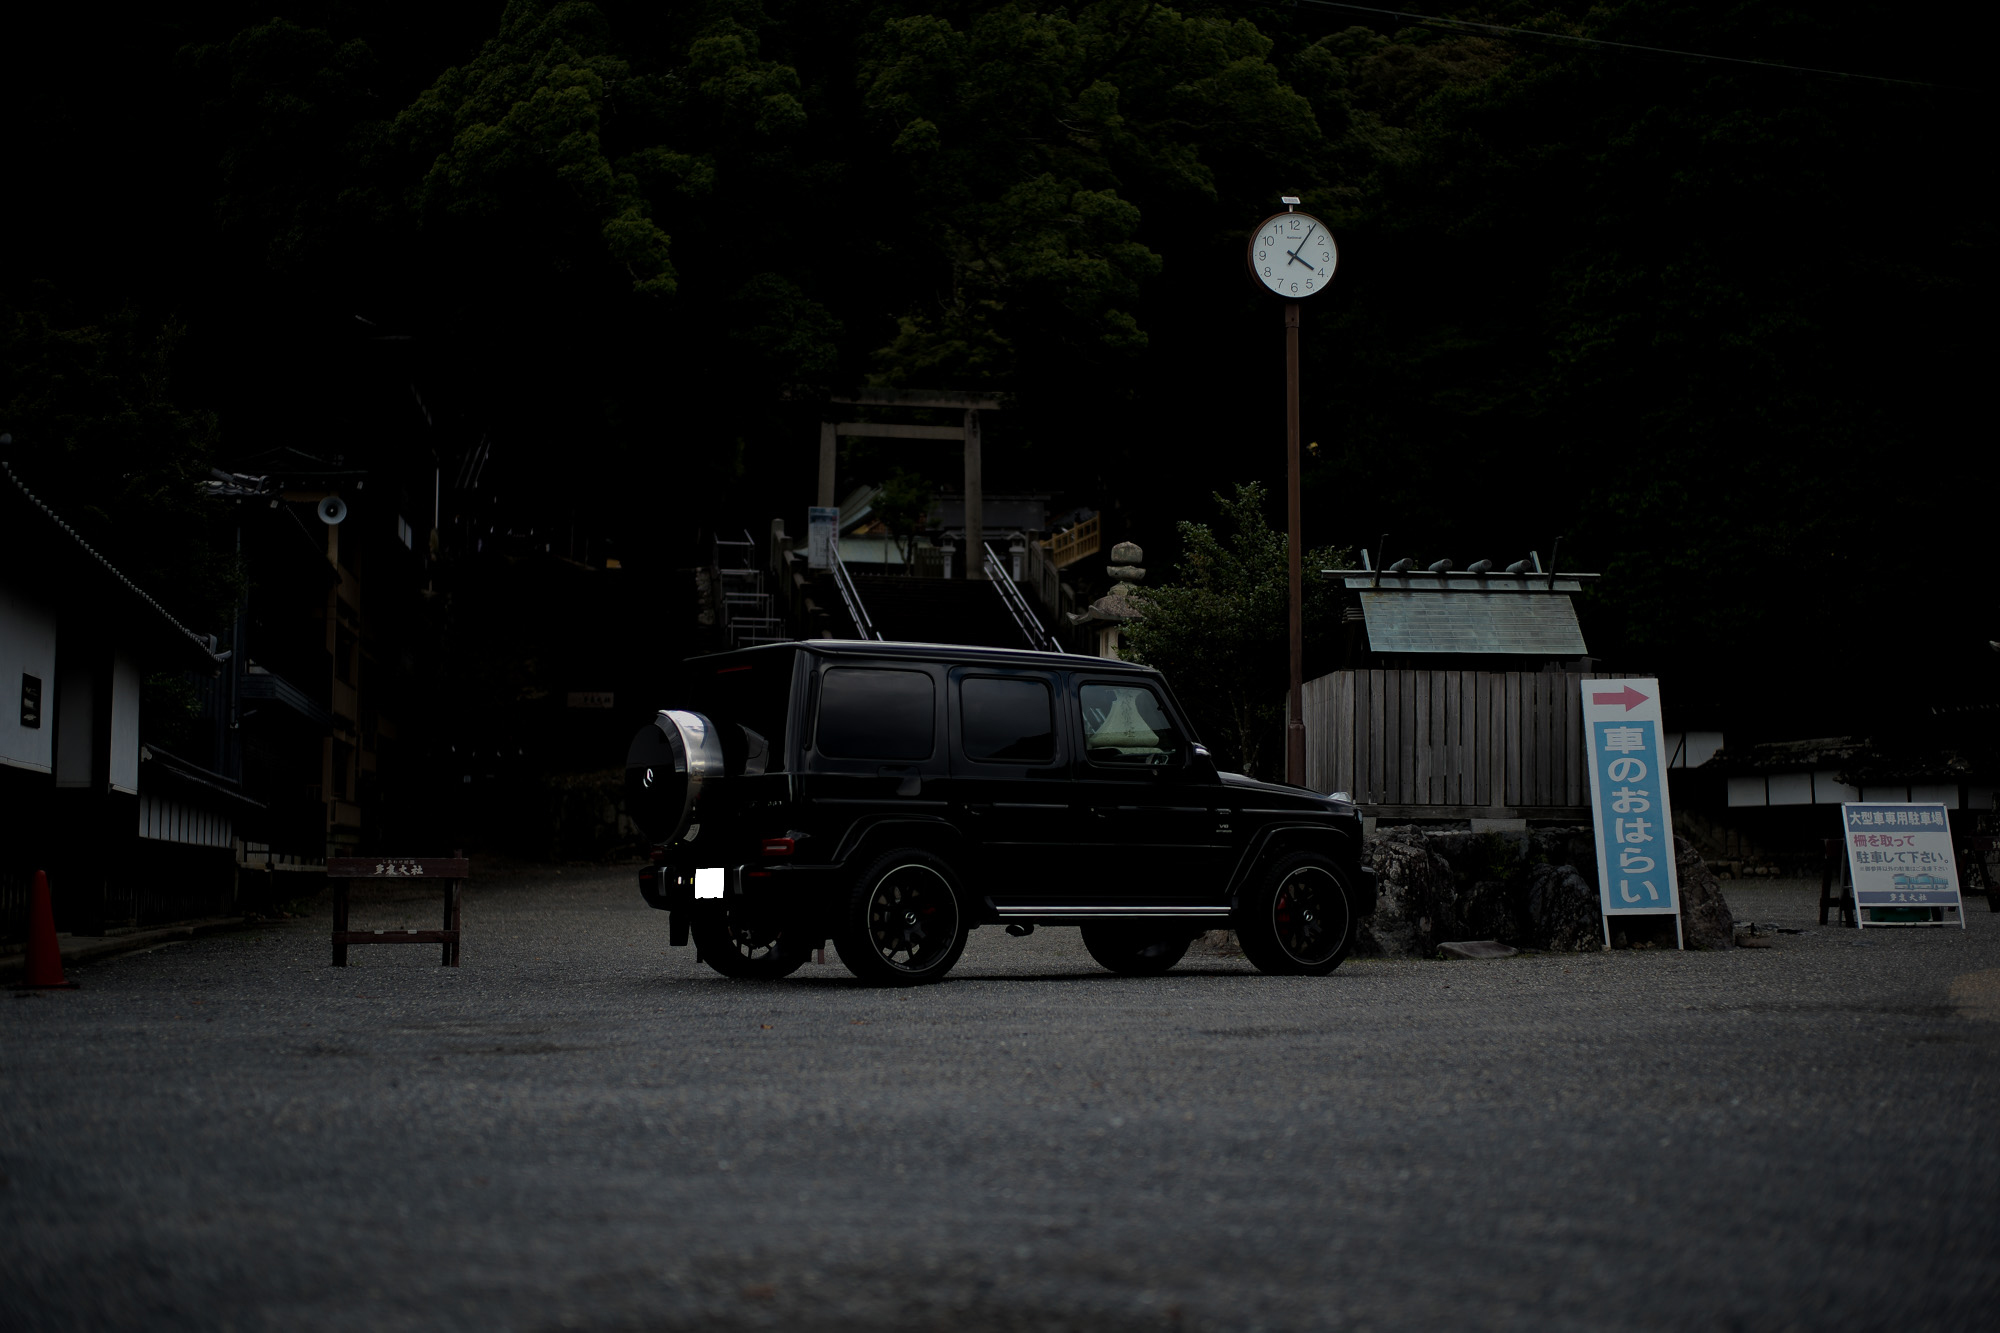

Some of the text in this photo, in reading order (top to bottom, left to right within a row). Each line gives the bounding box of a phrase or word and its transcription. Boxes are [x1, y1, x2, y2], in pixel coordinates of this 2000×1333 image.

[1274, 225, 1283, 234] 11
[1289, 220, 1300, 230] 12
[1263, 236, 1274, 246] 10
[1318, 236, 1324, 245] 2
[1259, 251, 1266, 260] 9
[1322, 252, 1329, 262] 3
[1264, 267, 1271, 277] 8
[1318, 268, 1324, 277] 4
[1277, 279, 1283, 288] 7
[1291, 283, 1298, 292] 6
[1306, 279, 1313, 288] 5
[1603, 726, 1659, 903] 車のおはらい
[1850, 811, 1944, 825] 大型車専用駐車場
[1854, 835, 1915, 847] 柵を取って
[1856, 851, 1948, 863] 駐車して下さい。
